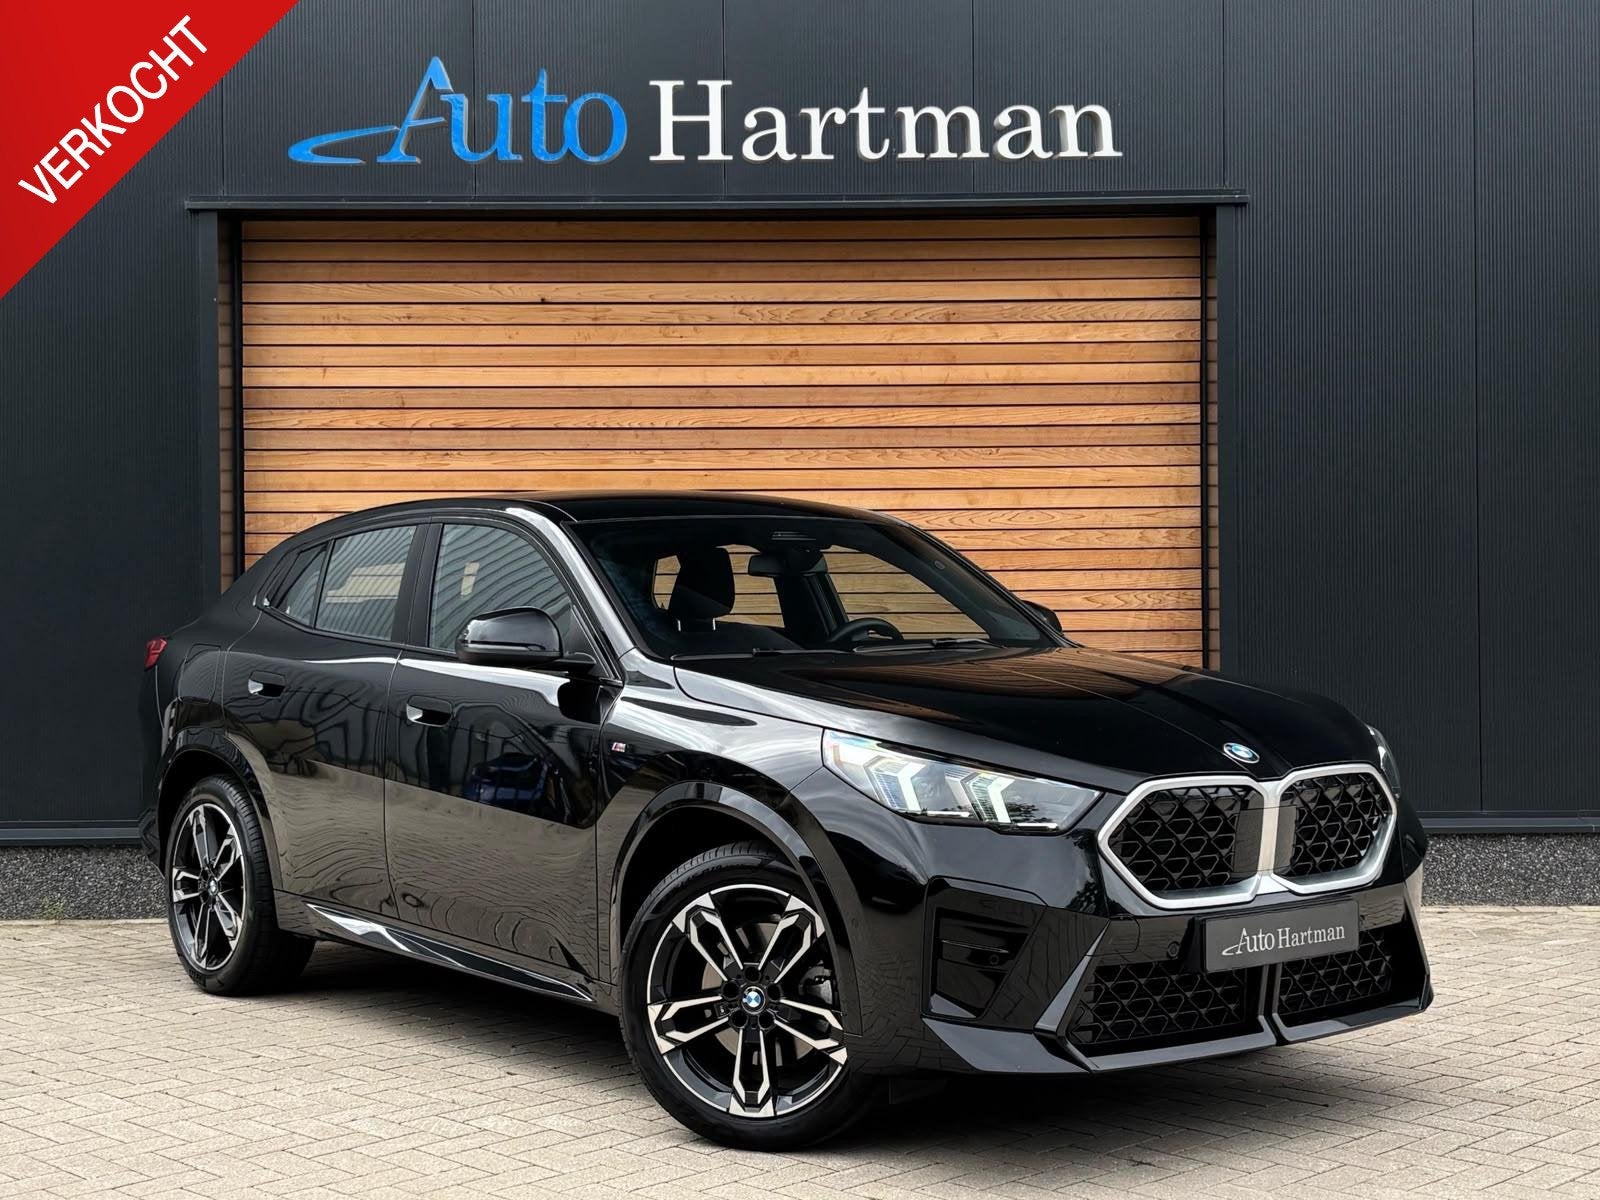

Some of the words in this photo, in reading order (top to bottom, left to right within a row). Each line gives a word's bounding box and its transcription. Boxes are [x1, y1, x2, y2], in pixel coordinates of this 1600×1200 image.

[288, 56, 628, 165] Auto
[649, 79, 1123, 163] Hartman
[1221, 927, 1276, 956] Auto
[1277, 925, 1345, 949] Hartman
